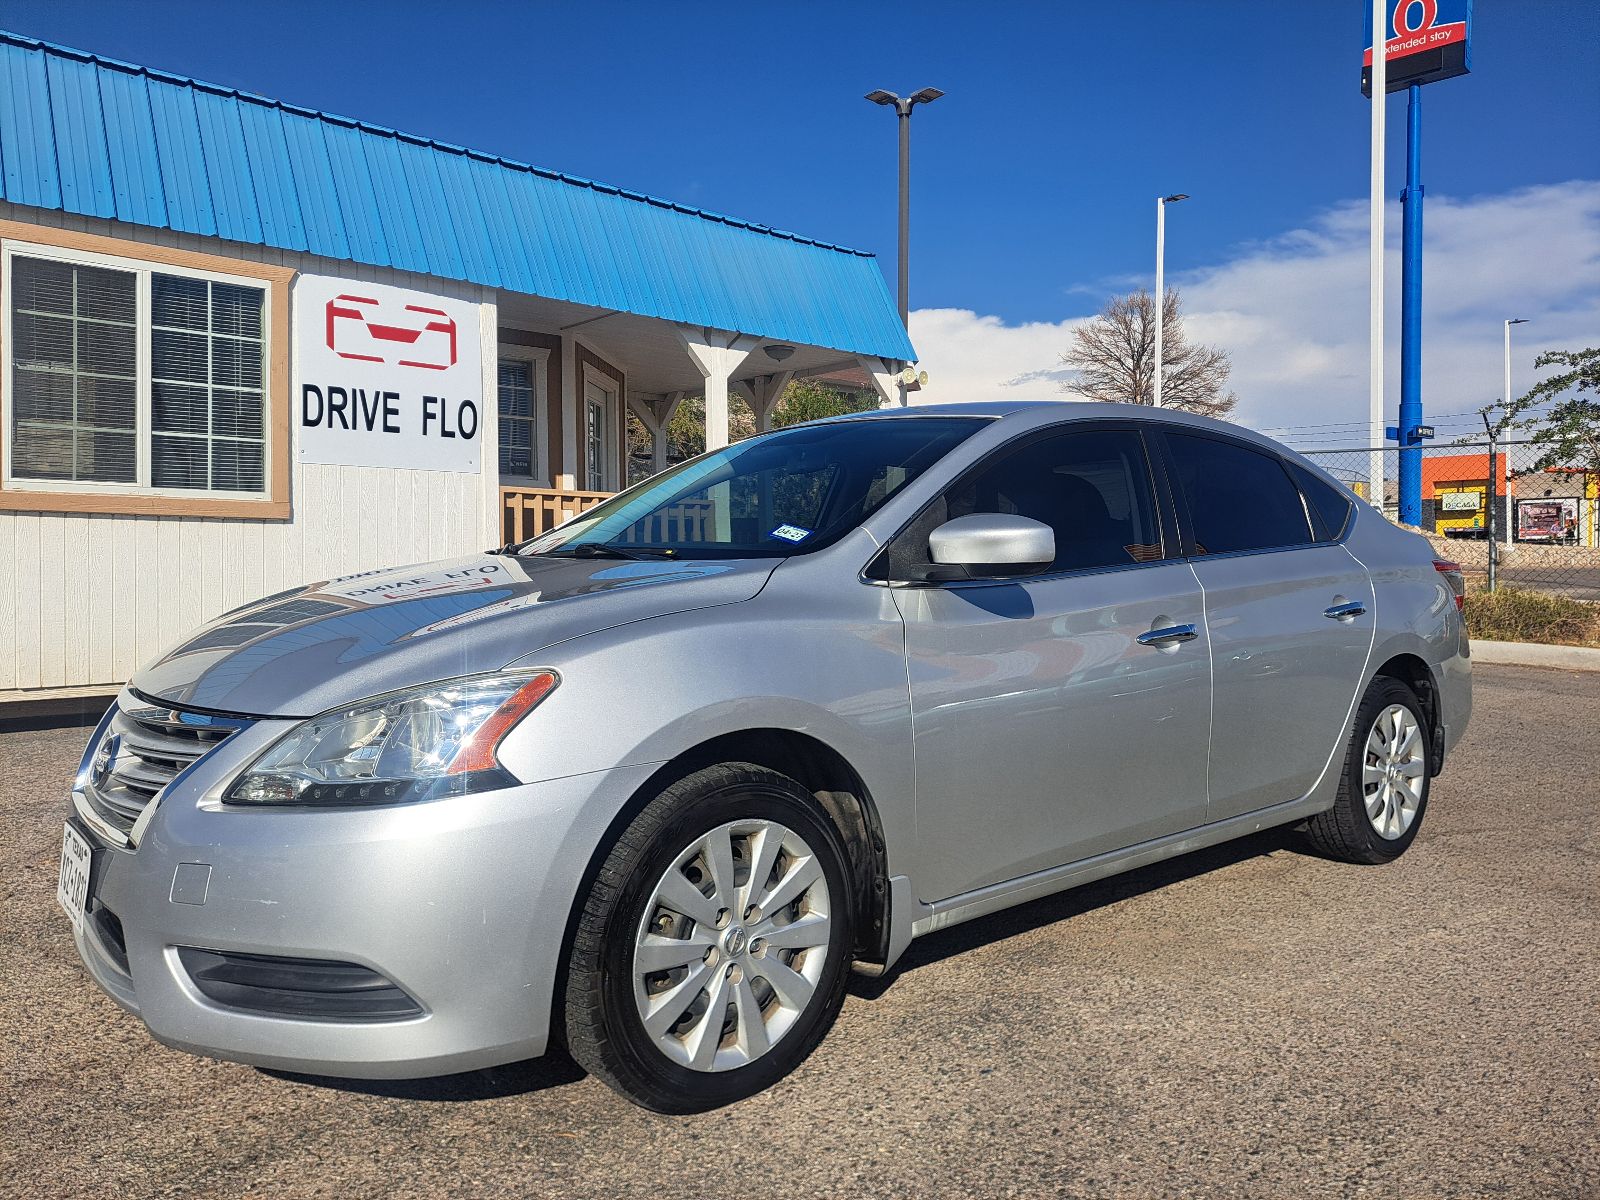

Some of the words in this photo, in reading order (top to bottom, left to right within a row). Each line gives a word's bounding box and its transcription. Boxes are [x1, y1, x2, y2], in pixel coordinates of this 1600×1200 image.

[1385, 35, 1426, 54] xtended
[1430, 30, 1452, 42] stay
[302, 383, 400, 434] DRIVE
[422, 395, 478, 440] FLO
